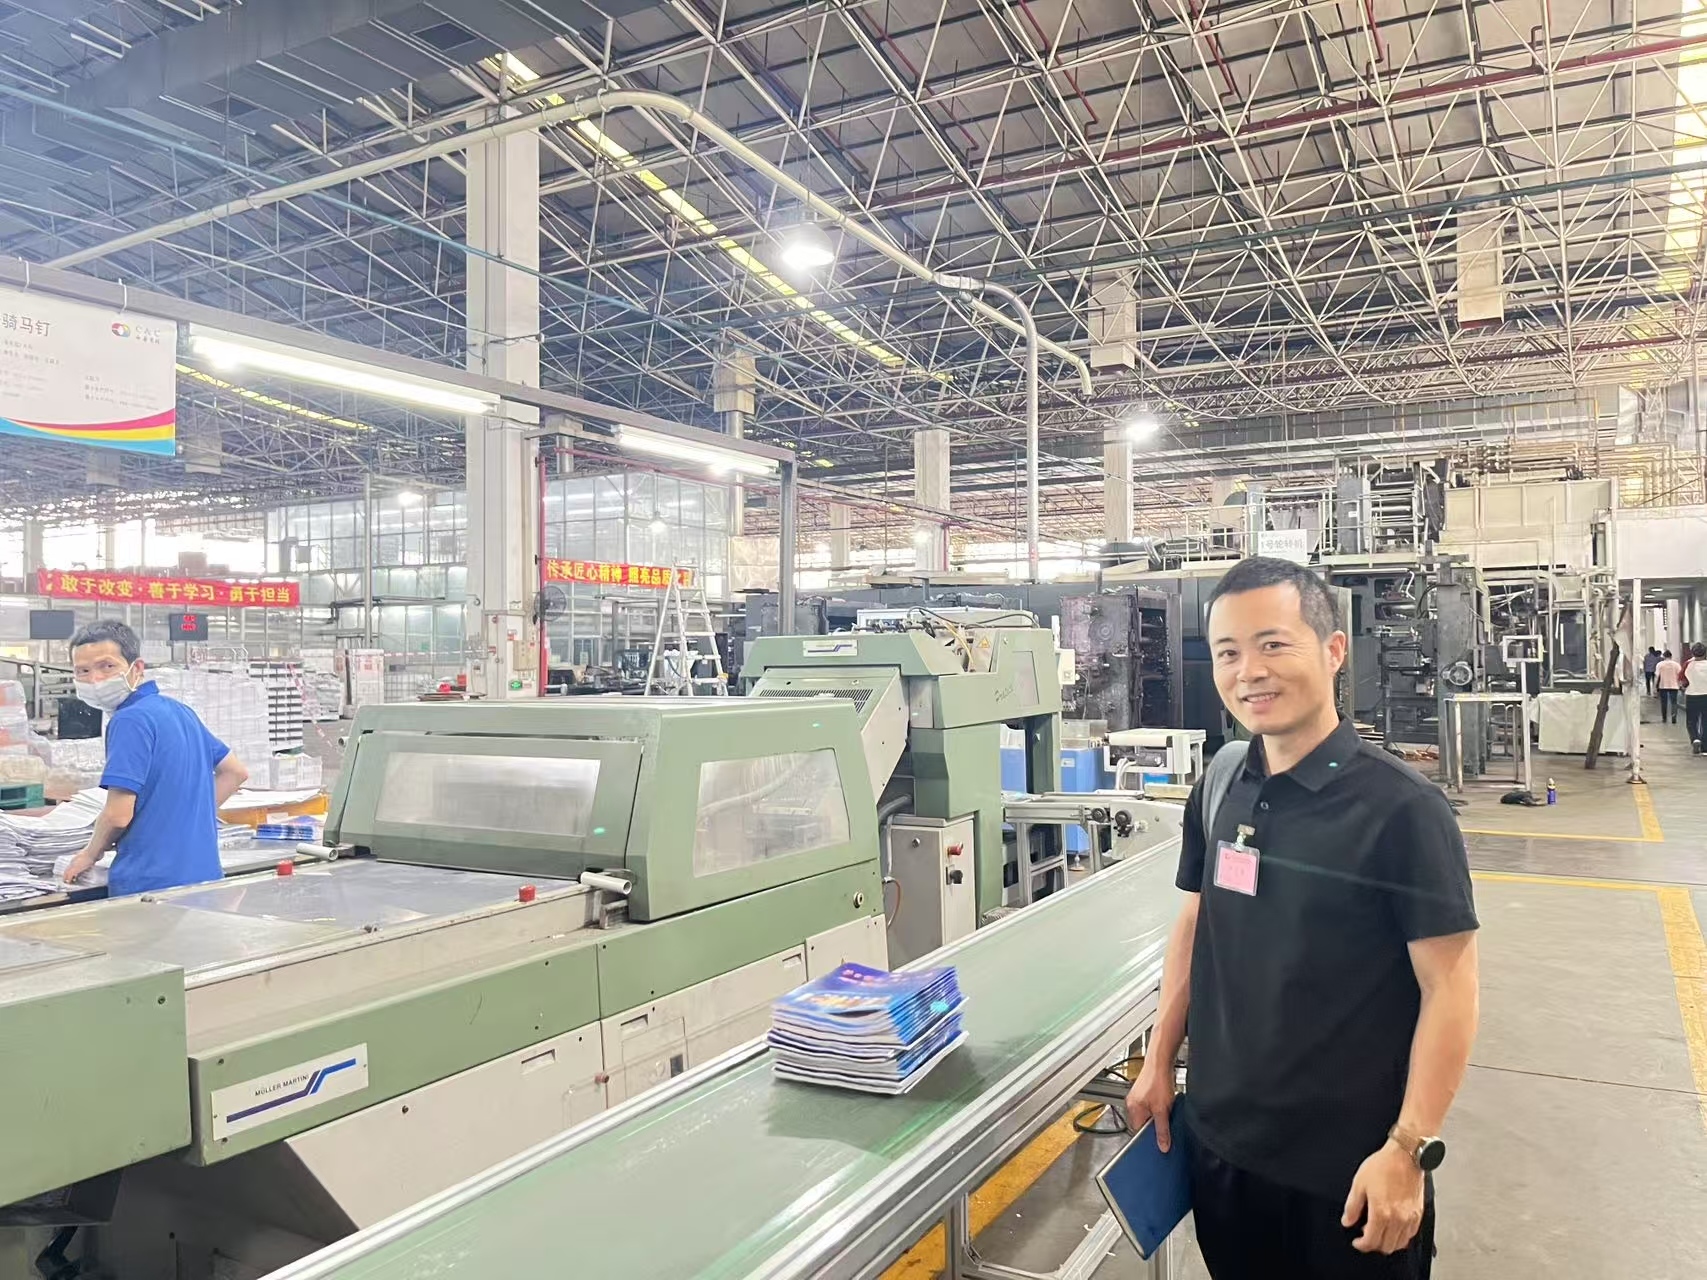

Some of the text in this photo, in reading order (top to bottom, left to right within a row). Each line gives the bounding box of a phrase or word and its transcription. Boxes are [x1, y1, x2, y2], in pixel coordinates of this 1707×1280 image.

[2, 313, 50, 337] 骑马钉
[547, 560, 623, 583] 传承匠心精神
[283, 1074, 309, 1087] MARTINI
